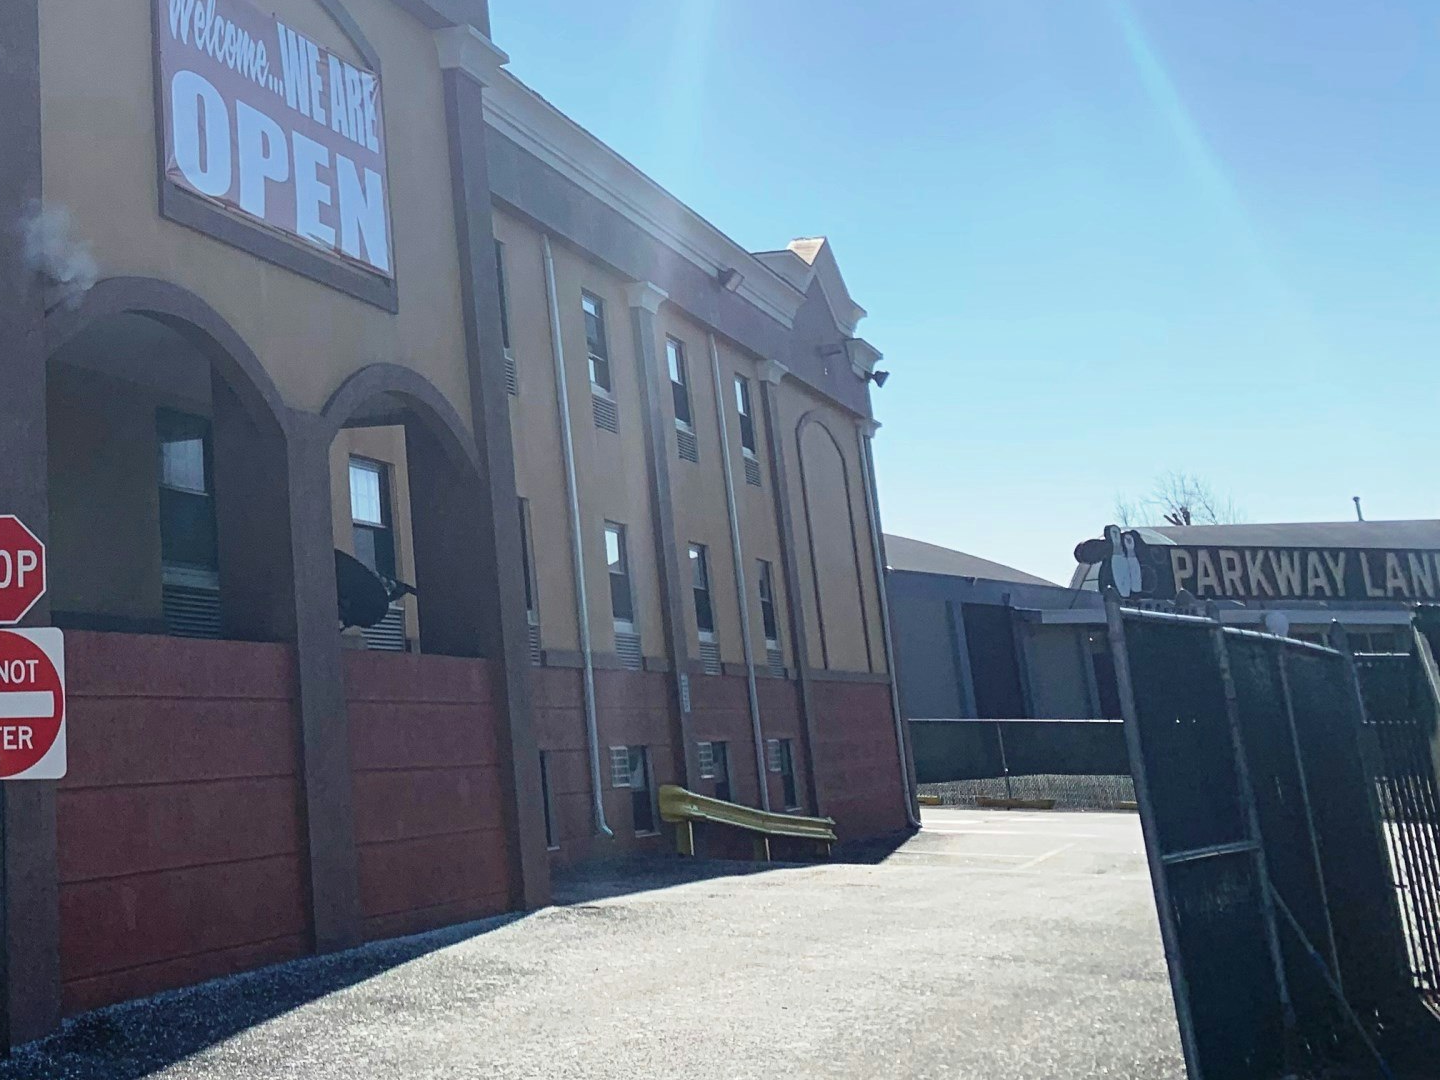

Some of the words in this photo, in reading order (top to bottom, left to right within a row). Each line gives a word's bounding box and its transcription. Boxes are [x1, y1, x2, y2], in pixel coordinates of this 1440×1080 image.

[327, 53, 380, 154] ARE
[171, 69, 390, 273] OPEN
[1169, 548, 1346, 598] PARKWAY
[1359, 550, 1440, 599] LAN
